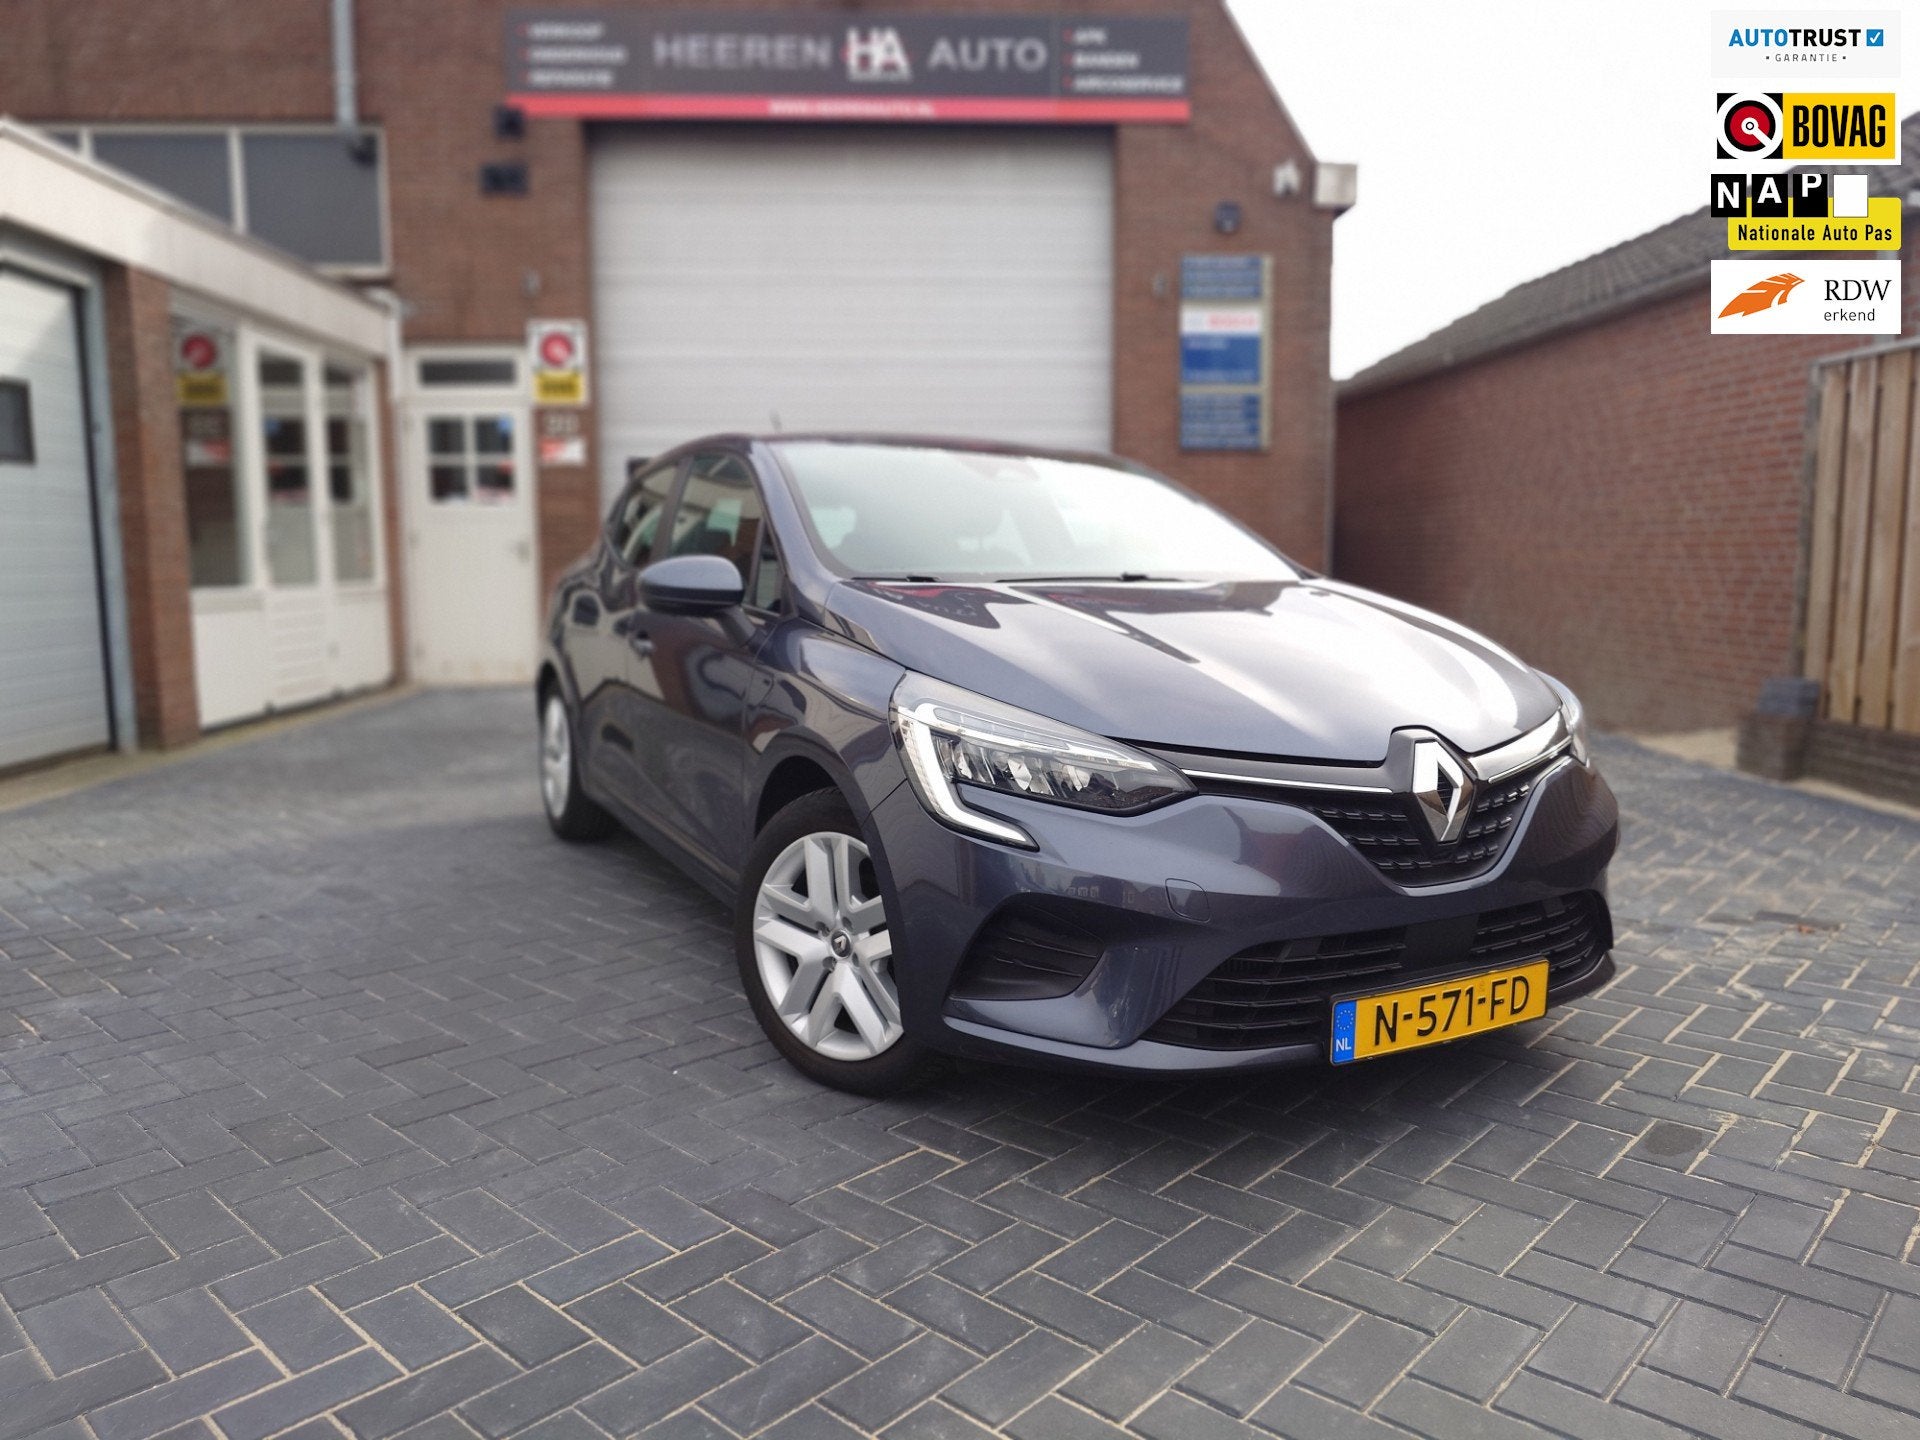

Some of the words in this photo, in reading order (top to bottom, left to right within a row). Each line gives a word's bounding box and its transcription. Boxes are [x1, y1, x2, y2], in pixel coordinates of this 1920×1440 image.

[654, 33, 832, 70] HEEREN
[927, 37, 1047, 71] AUTO
[1335, 1037, 1352, 1052] NL
[1374, 975, 1530, 1046] N-571-FD
